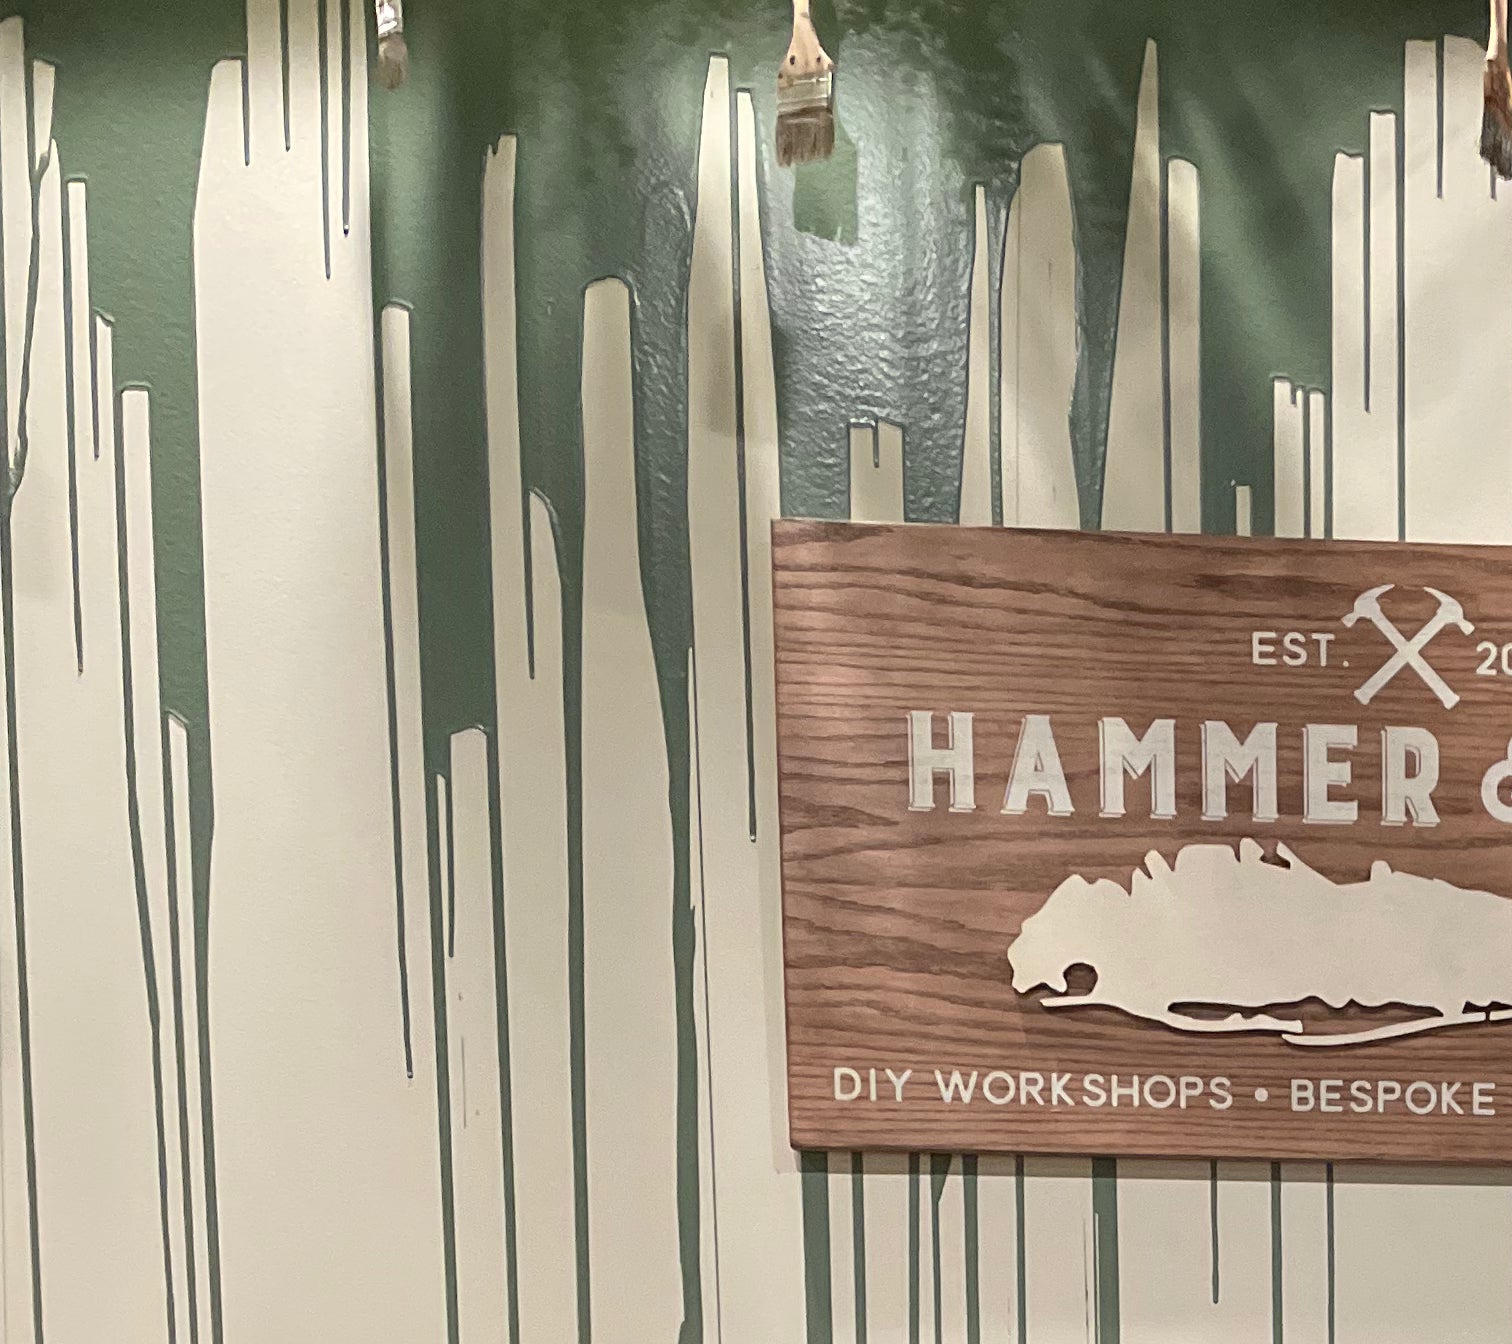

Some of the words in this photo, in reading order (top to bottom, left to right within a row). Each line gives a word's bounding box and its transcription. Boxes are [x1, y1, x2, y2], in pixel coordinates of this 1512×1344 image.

[1251, 630, 1350, 668] EST.
[905, 709, 1441, 828] HAMMER
[833, 1066, 912, 1102] DIY
[934, 1068, 1234, 1111] WORKSHOPS
[1290, 1078, 1497, 1115] BESPOKE
